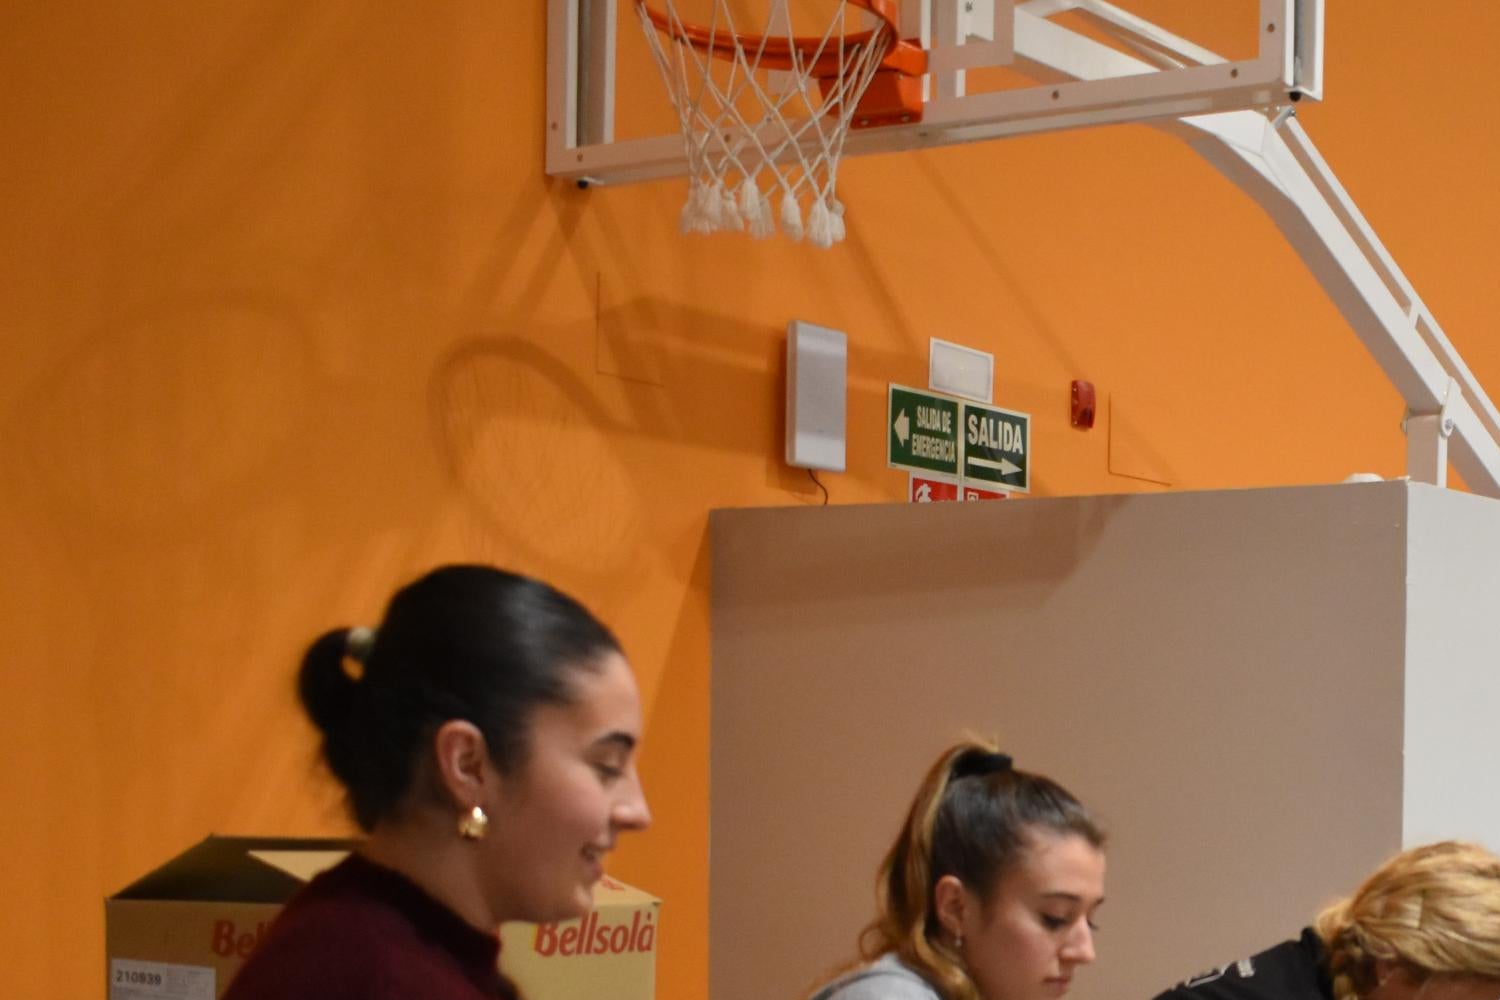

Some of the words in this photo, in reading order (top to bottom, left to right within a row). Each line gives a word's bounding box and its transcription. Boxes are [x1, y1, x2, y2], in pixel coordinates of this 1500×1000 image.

[916, 405, 940, 431] SALIDA
[942, 411, 951, 433] DE
[911, 433, 956, 463] EMERGENCIA
[968, 414, 1023, 455] SALIDA
